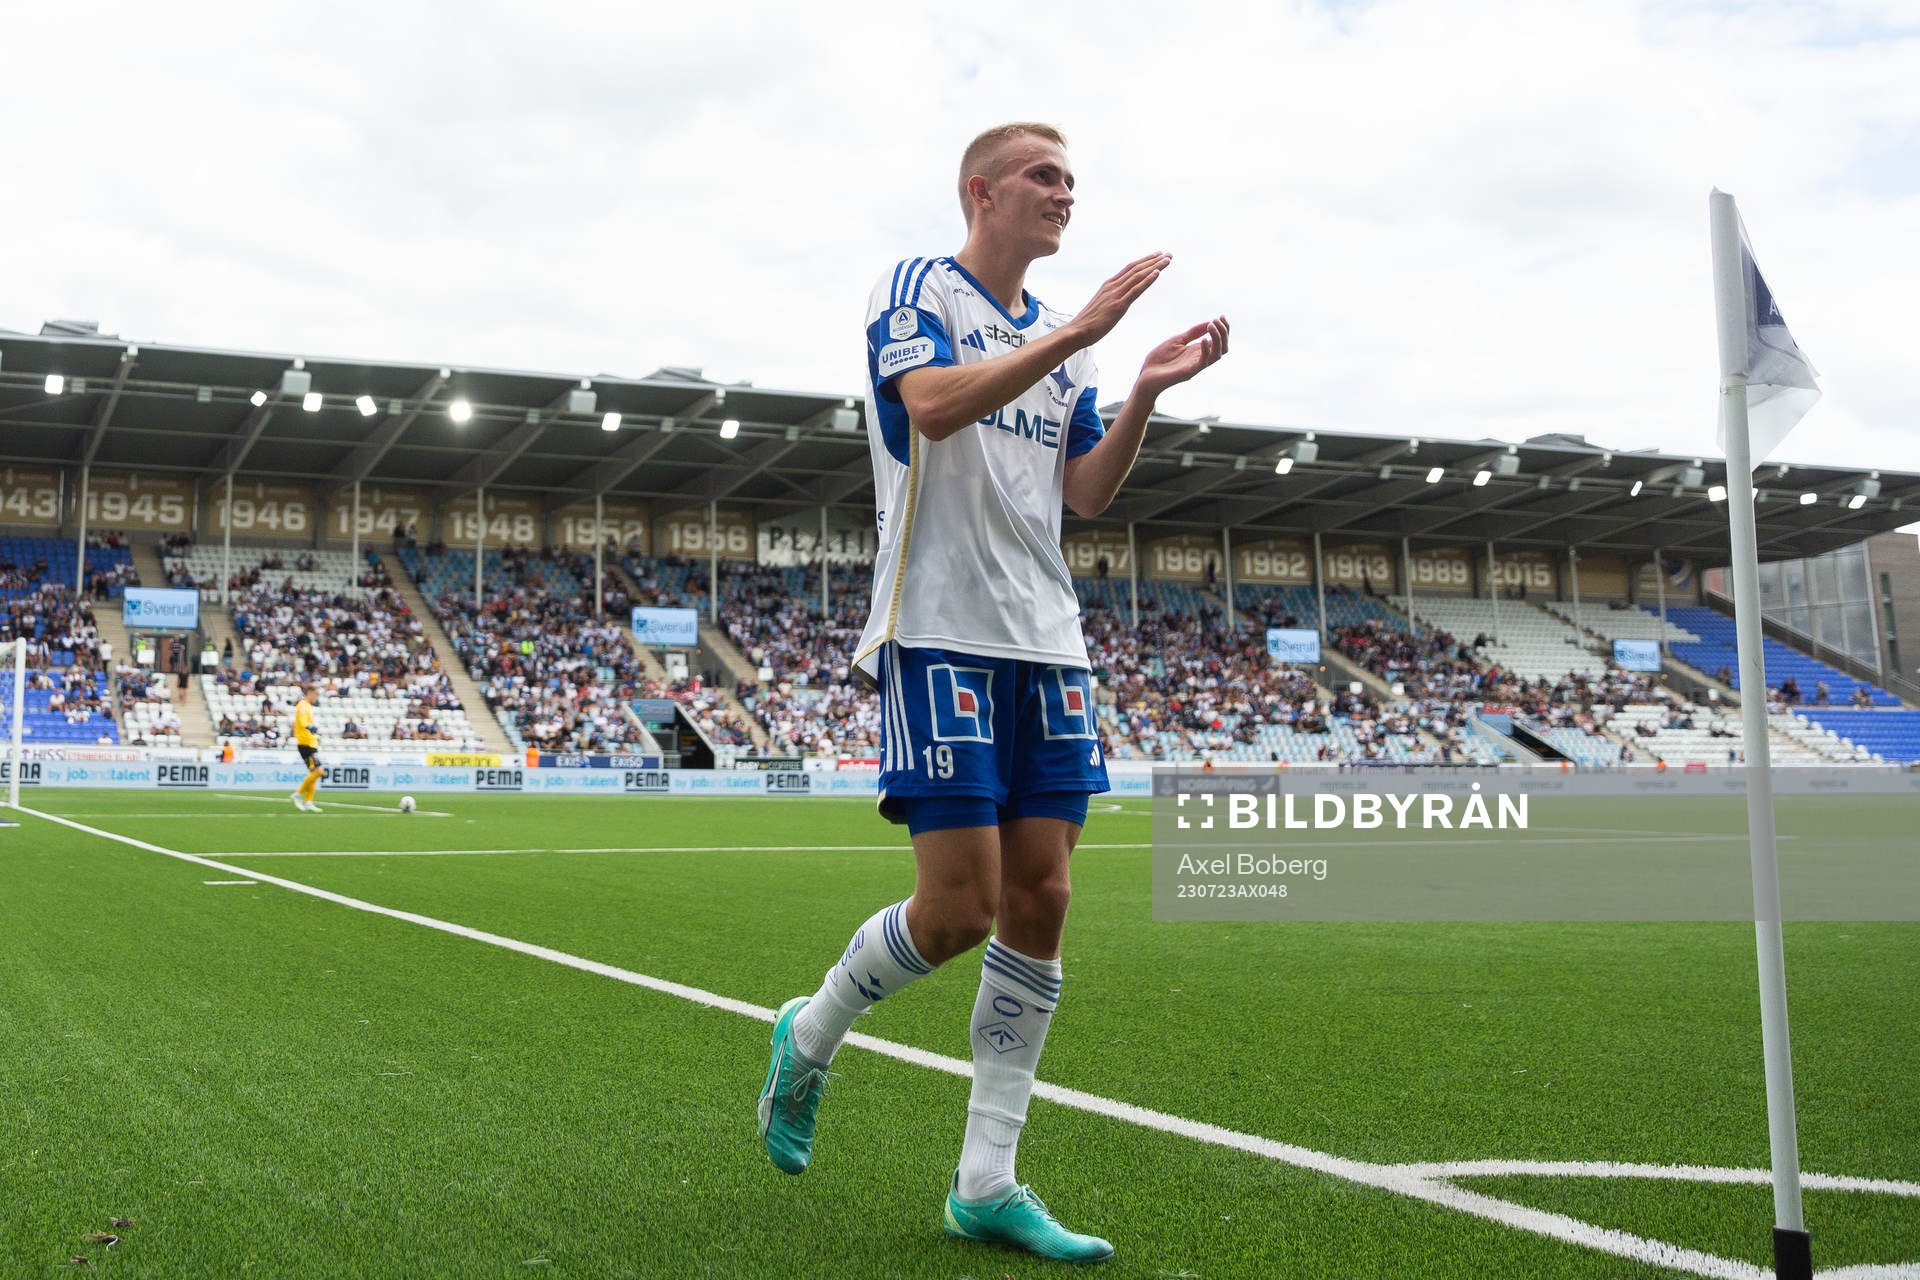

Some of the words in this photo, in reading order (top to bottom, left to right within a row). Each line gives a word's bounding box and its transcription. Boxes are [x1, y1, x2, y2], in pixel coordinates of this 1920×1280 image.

[984, 324, 1029, 349] stadi
[882, 344, 928, 363] UNIBET
[0, 487, 57, 518] 43
[87, 491, 184, 525] 1945
[217, 501, 306, 531] 1946
[337, 505, 421, 534] 1947
[451, 512, 534, 543] 1948
[562, 517, 643, 546] 1952
[669, 523, 748, 552] 1956
[1065, 542, 1131, 569] 1957
[1154, 546, 1222, 573] 1960
[1240, 551, 1307, 578] 1962
[1327, 554, 1389, 580] 1963
[1407, 558, 1467, 584] 1989
[1487, 562, 1550, 587] 2015
[158, 766, 208, 781] PEMA
[321, 768, 369, 784] PEMA
[923, 745, 954, 780] 19
[477, 770, 522, 785] PEMA
[625, 772, 669, 787] PEMA
[766, 774, 810, 788] PEMA
